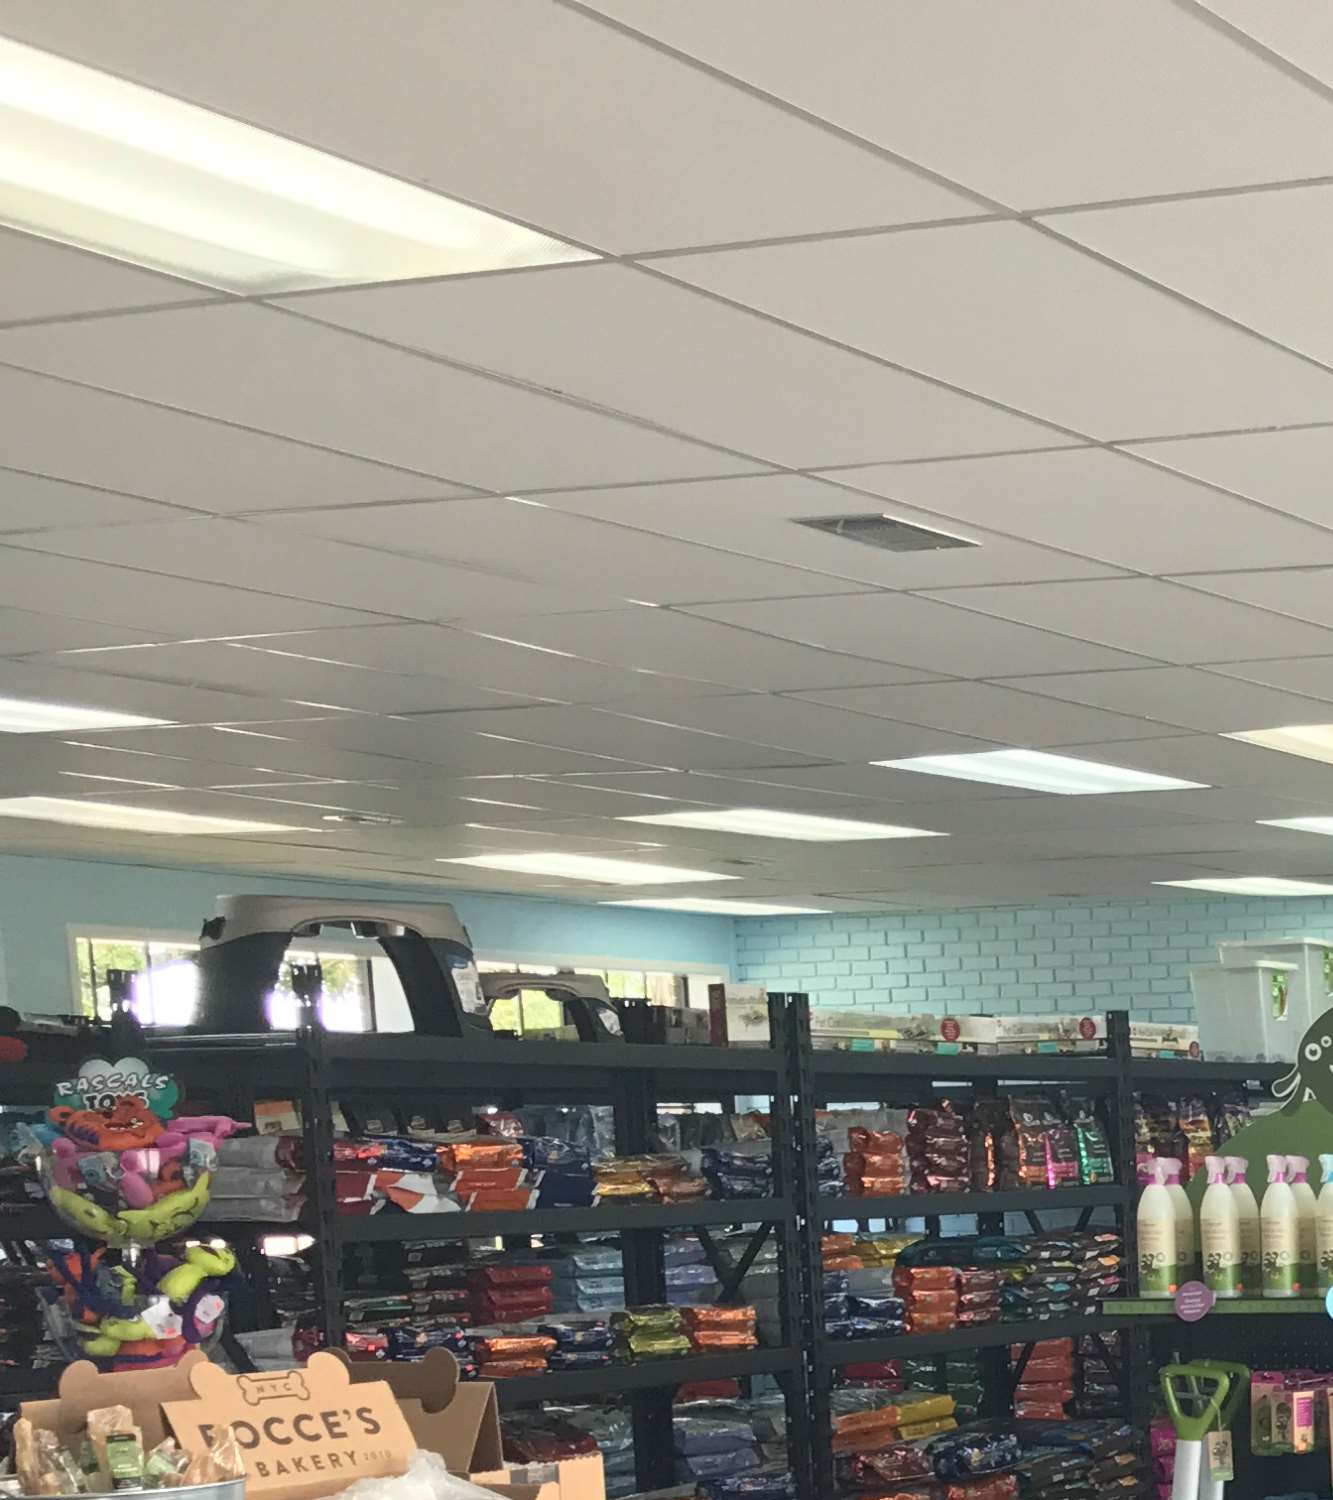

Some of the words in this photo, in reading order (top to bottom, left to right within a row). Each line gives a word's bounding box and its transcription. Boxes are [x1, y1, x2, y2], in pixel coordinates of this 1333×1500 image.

[56, 1072, 169, 1096] RASCALS
[83, 1090, 149, 1112] TO
[256, 1382, 292, 1393] NYC
[255, 1451, 359, 1477] BAKERY
